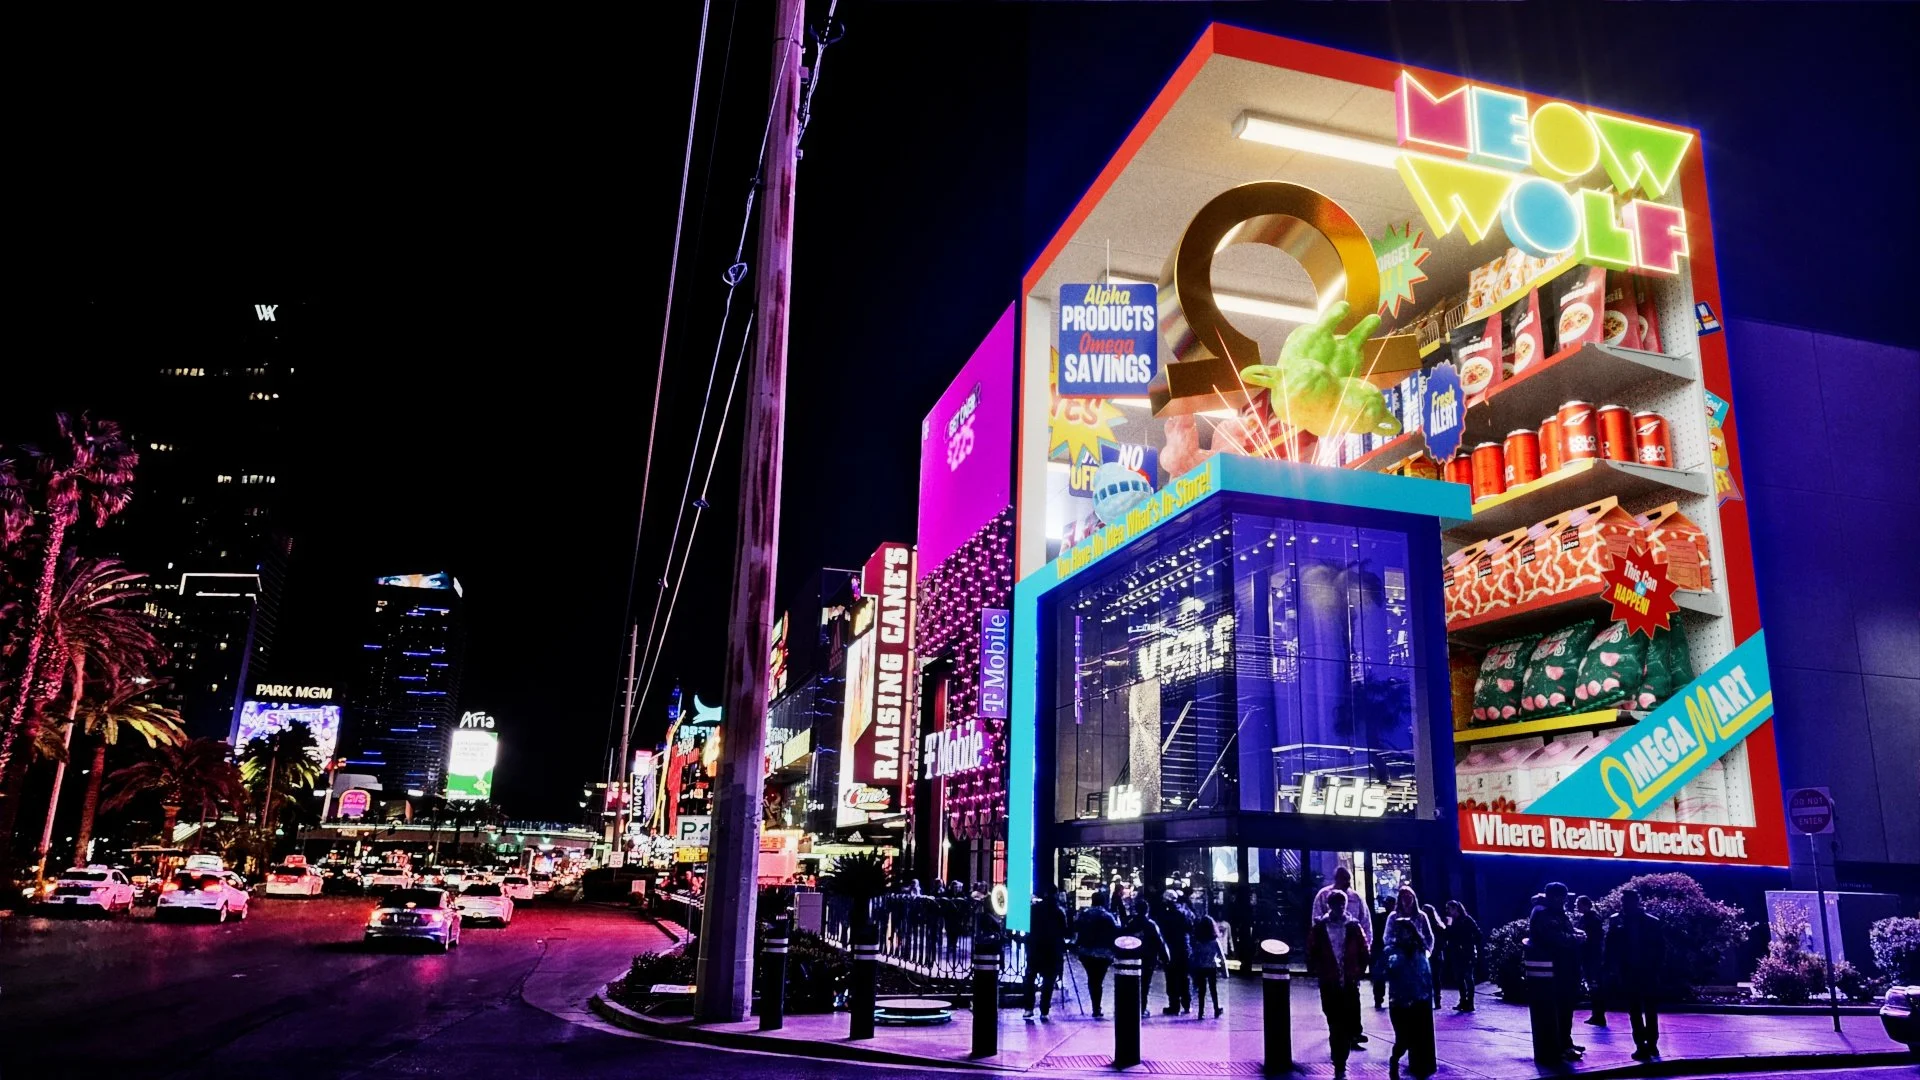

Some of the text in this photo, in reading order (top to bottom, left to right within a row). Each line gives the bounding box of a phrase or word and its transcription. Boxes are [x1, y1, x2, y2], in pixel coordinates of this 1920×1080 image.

[1395, 70, 1694, 200] MEOW
[1395, 152, 1690, 275] WOLF
[1084, 285, 1131, 309] Alpha
[1061, 305, 1155, 331] PRODUCTS
[1079, 331, 1135, 359] Omega
[1064, 354, 1152, 383] SAVINGS
[1431, 383, 1456, 412] Fresh
[1430, 400, 1458, 437] ALERT
[1118, 444, 1145, 471] NO
[1105, 524, 1126, 550] Idea
[1623, 559, 1642, 584] This
[1641, 570, 1658, 593] Can
[874, 547, 909, 780] RAISING CANE'S
[255, 684, 333, 699] PARK MGM
[1684, 664, 1756, 744] MART
[459, 711, 495, 728] Aria
[1108, 784, 1143, 820] Lids
[1300, 774, 1388, 818] Lids
[1807, 797, 1823, 805] NOT
[1800, 817, 1823, 825] ENTER
[1471, 813, 1748, 860] Where Reality Checks Out
